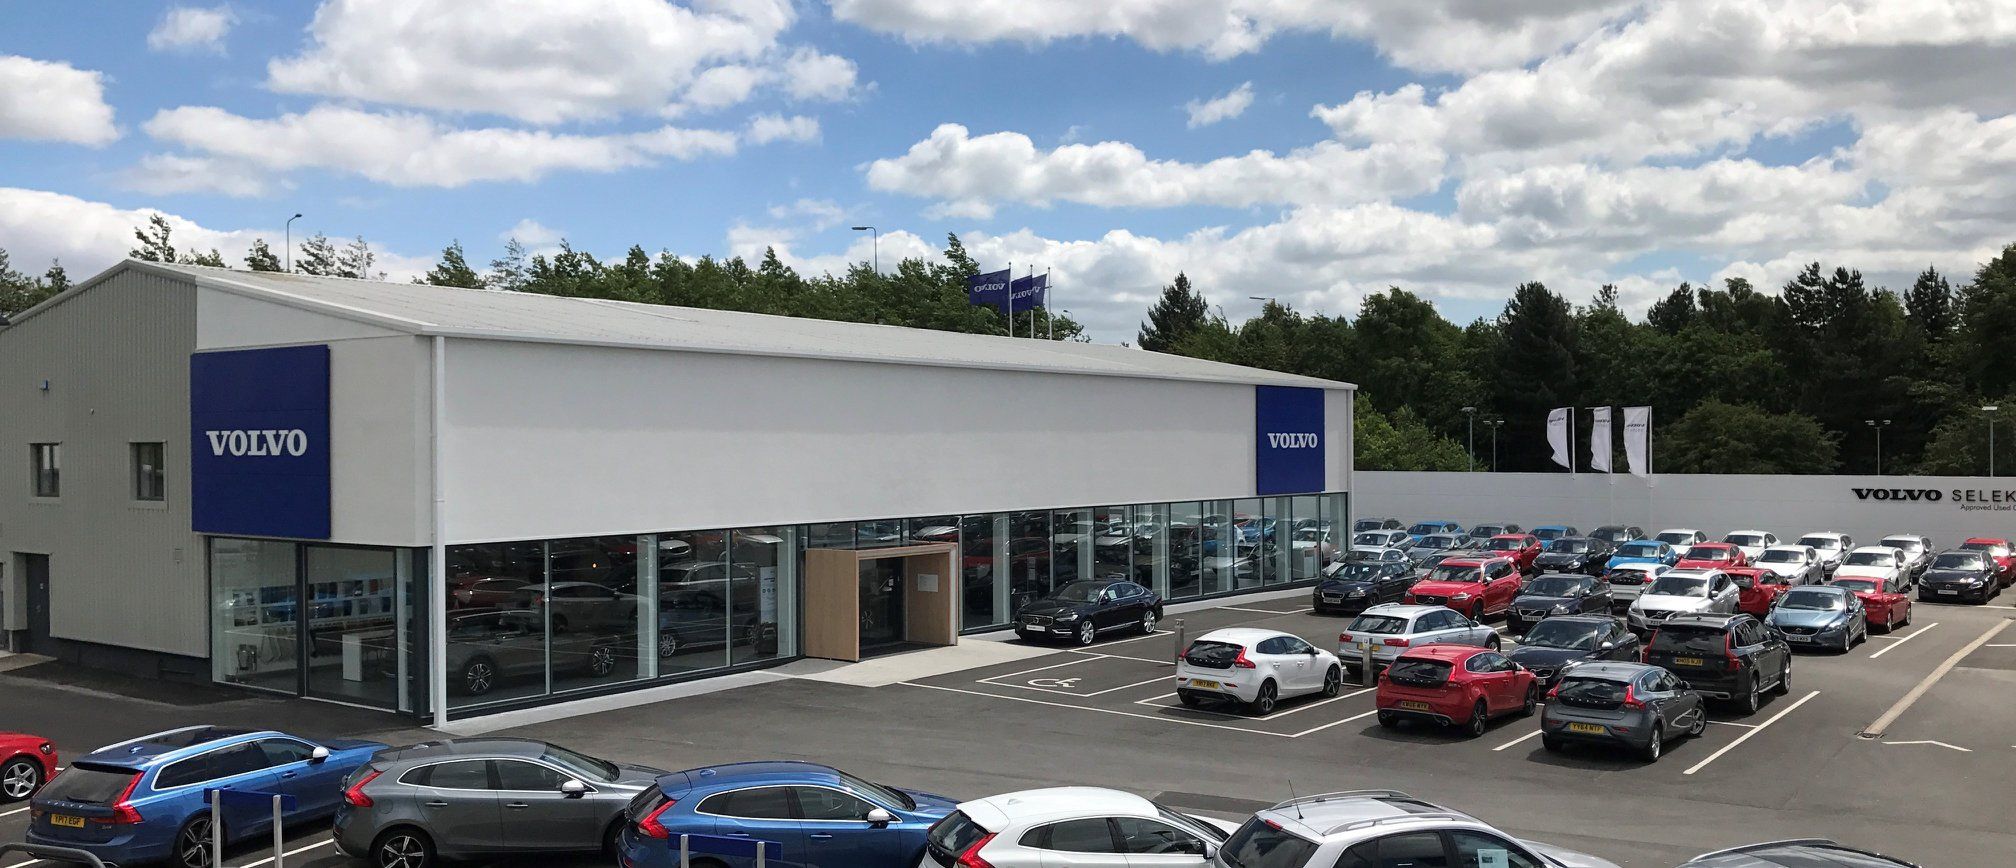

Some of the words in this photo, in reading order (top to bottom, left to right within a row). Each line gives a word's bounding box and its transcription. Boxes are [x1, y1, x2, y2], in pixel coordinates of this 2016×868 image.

[206, 429, 307, 456] VOLVO
[1267, 433, 1318, 448] VOLVO
[1851, 488, 1943, 501] VOLVO
